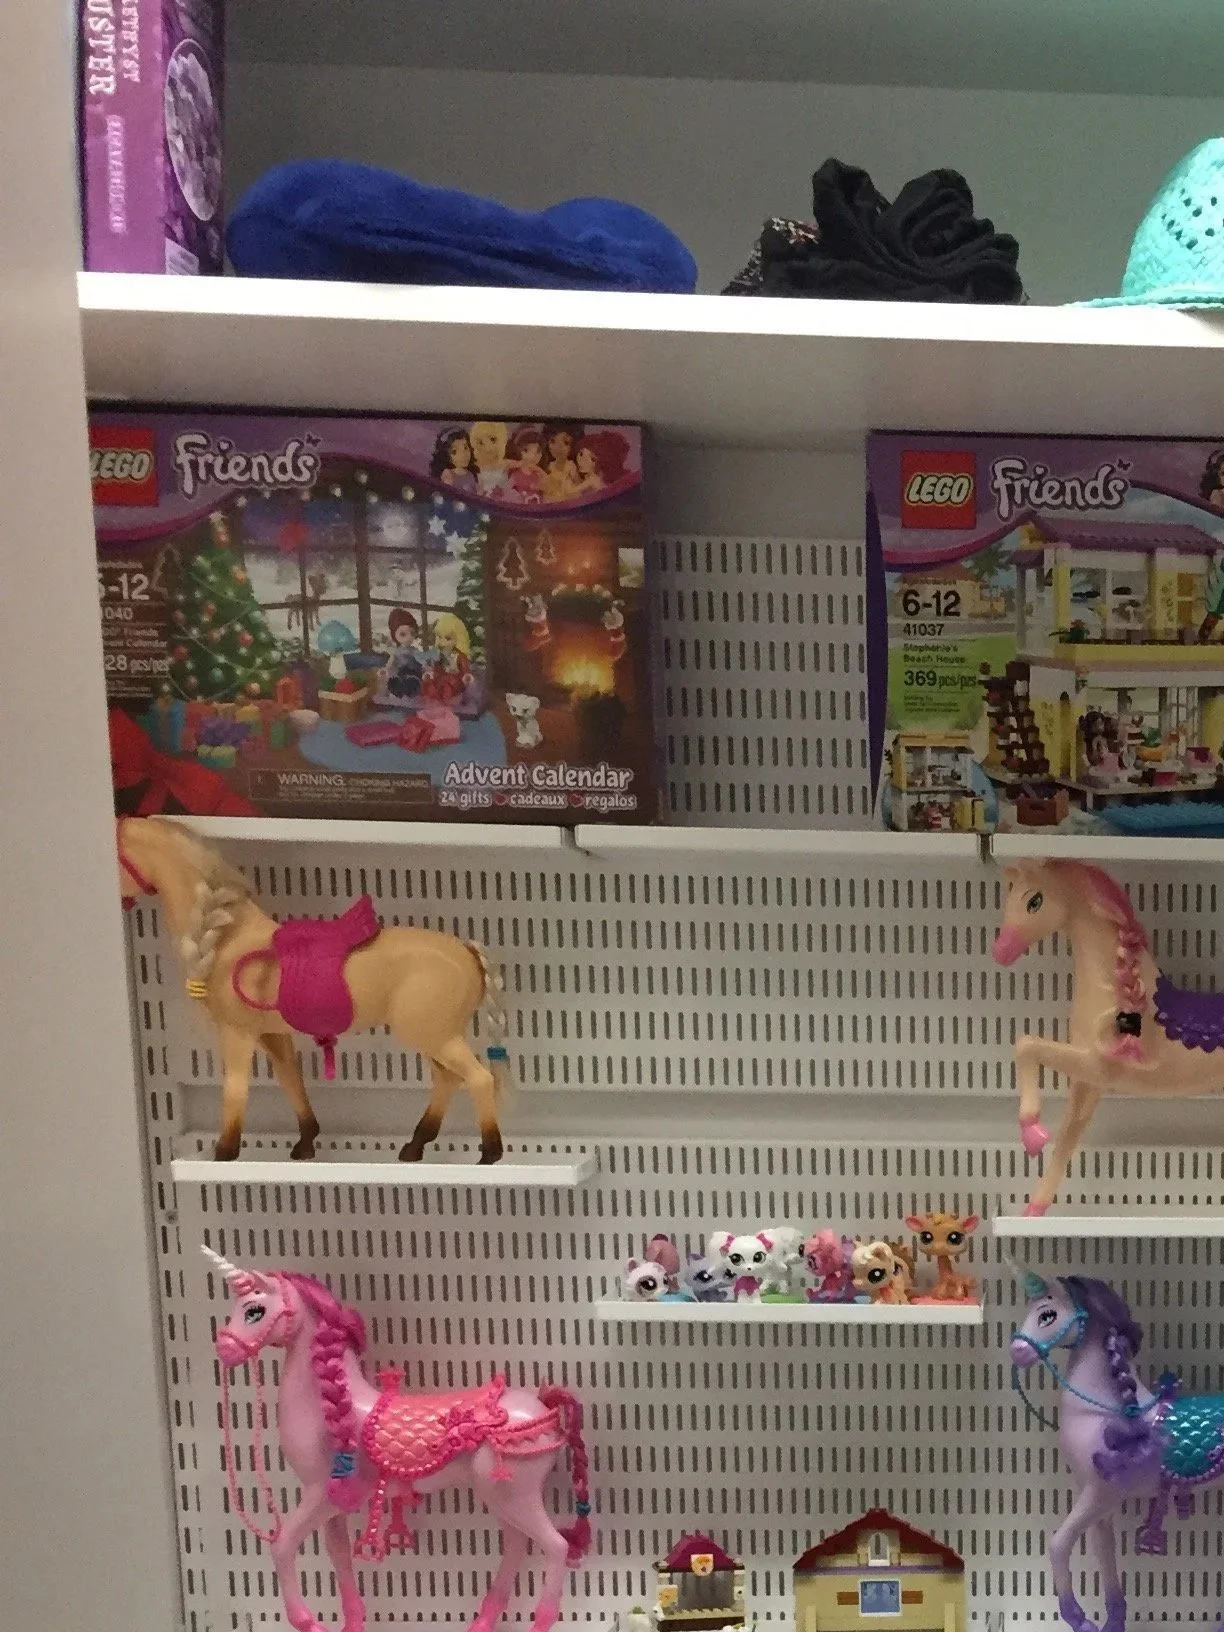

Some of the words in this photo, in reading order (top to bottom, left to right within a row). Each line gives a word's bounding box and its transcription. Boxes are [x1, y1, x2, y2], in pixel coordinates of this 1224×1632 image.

[89, 451, 151, 479] LEGO
[176, 433, 315, 494] Friends
[907, 474, 971, 504] LEGO
[993, 458, 1126, 519] Friends
[902, 589, 961, 617] 6-12
[902, 623, 945, 636] 41037
[904, 670, 937, 686] 369
[445, 763, 527, 786] Advent
[532, 764, 631, 789] Calendar
[441, 791, 456, 803] 24
[460, 790, 491, 808] gifts
[511, 792, 566, 805] cadeaux
[585, 793, 635, 810] regalos
